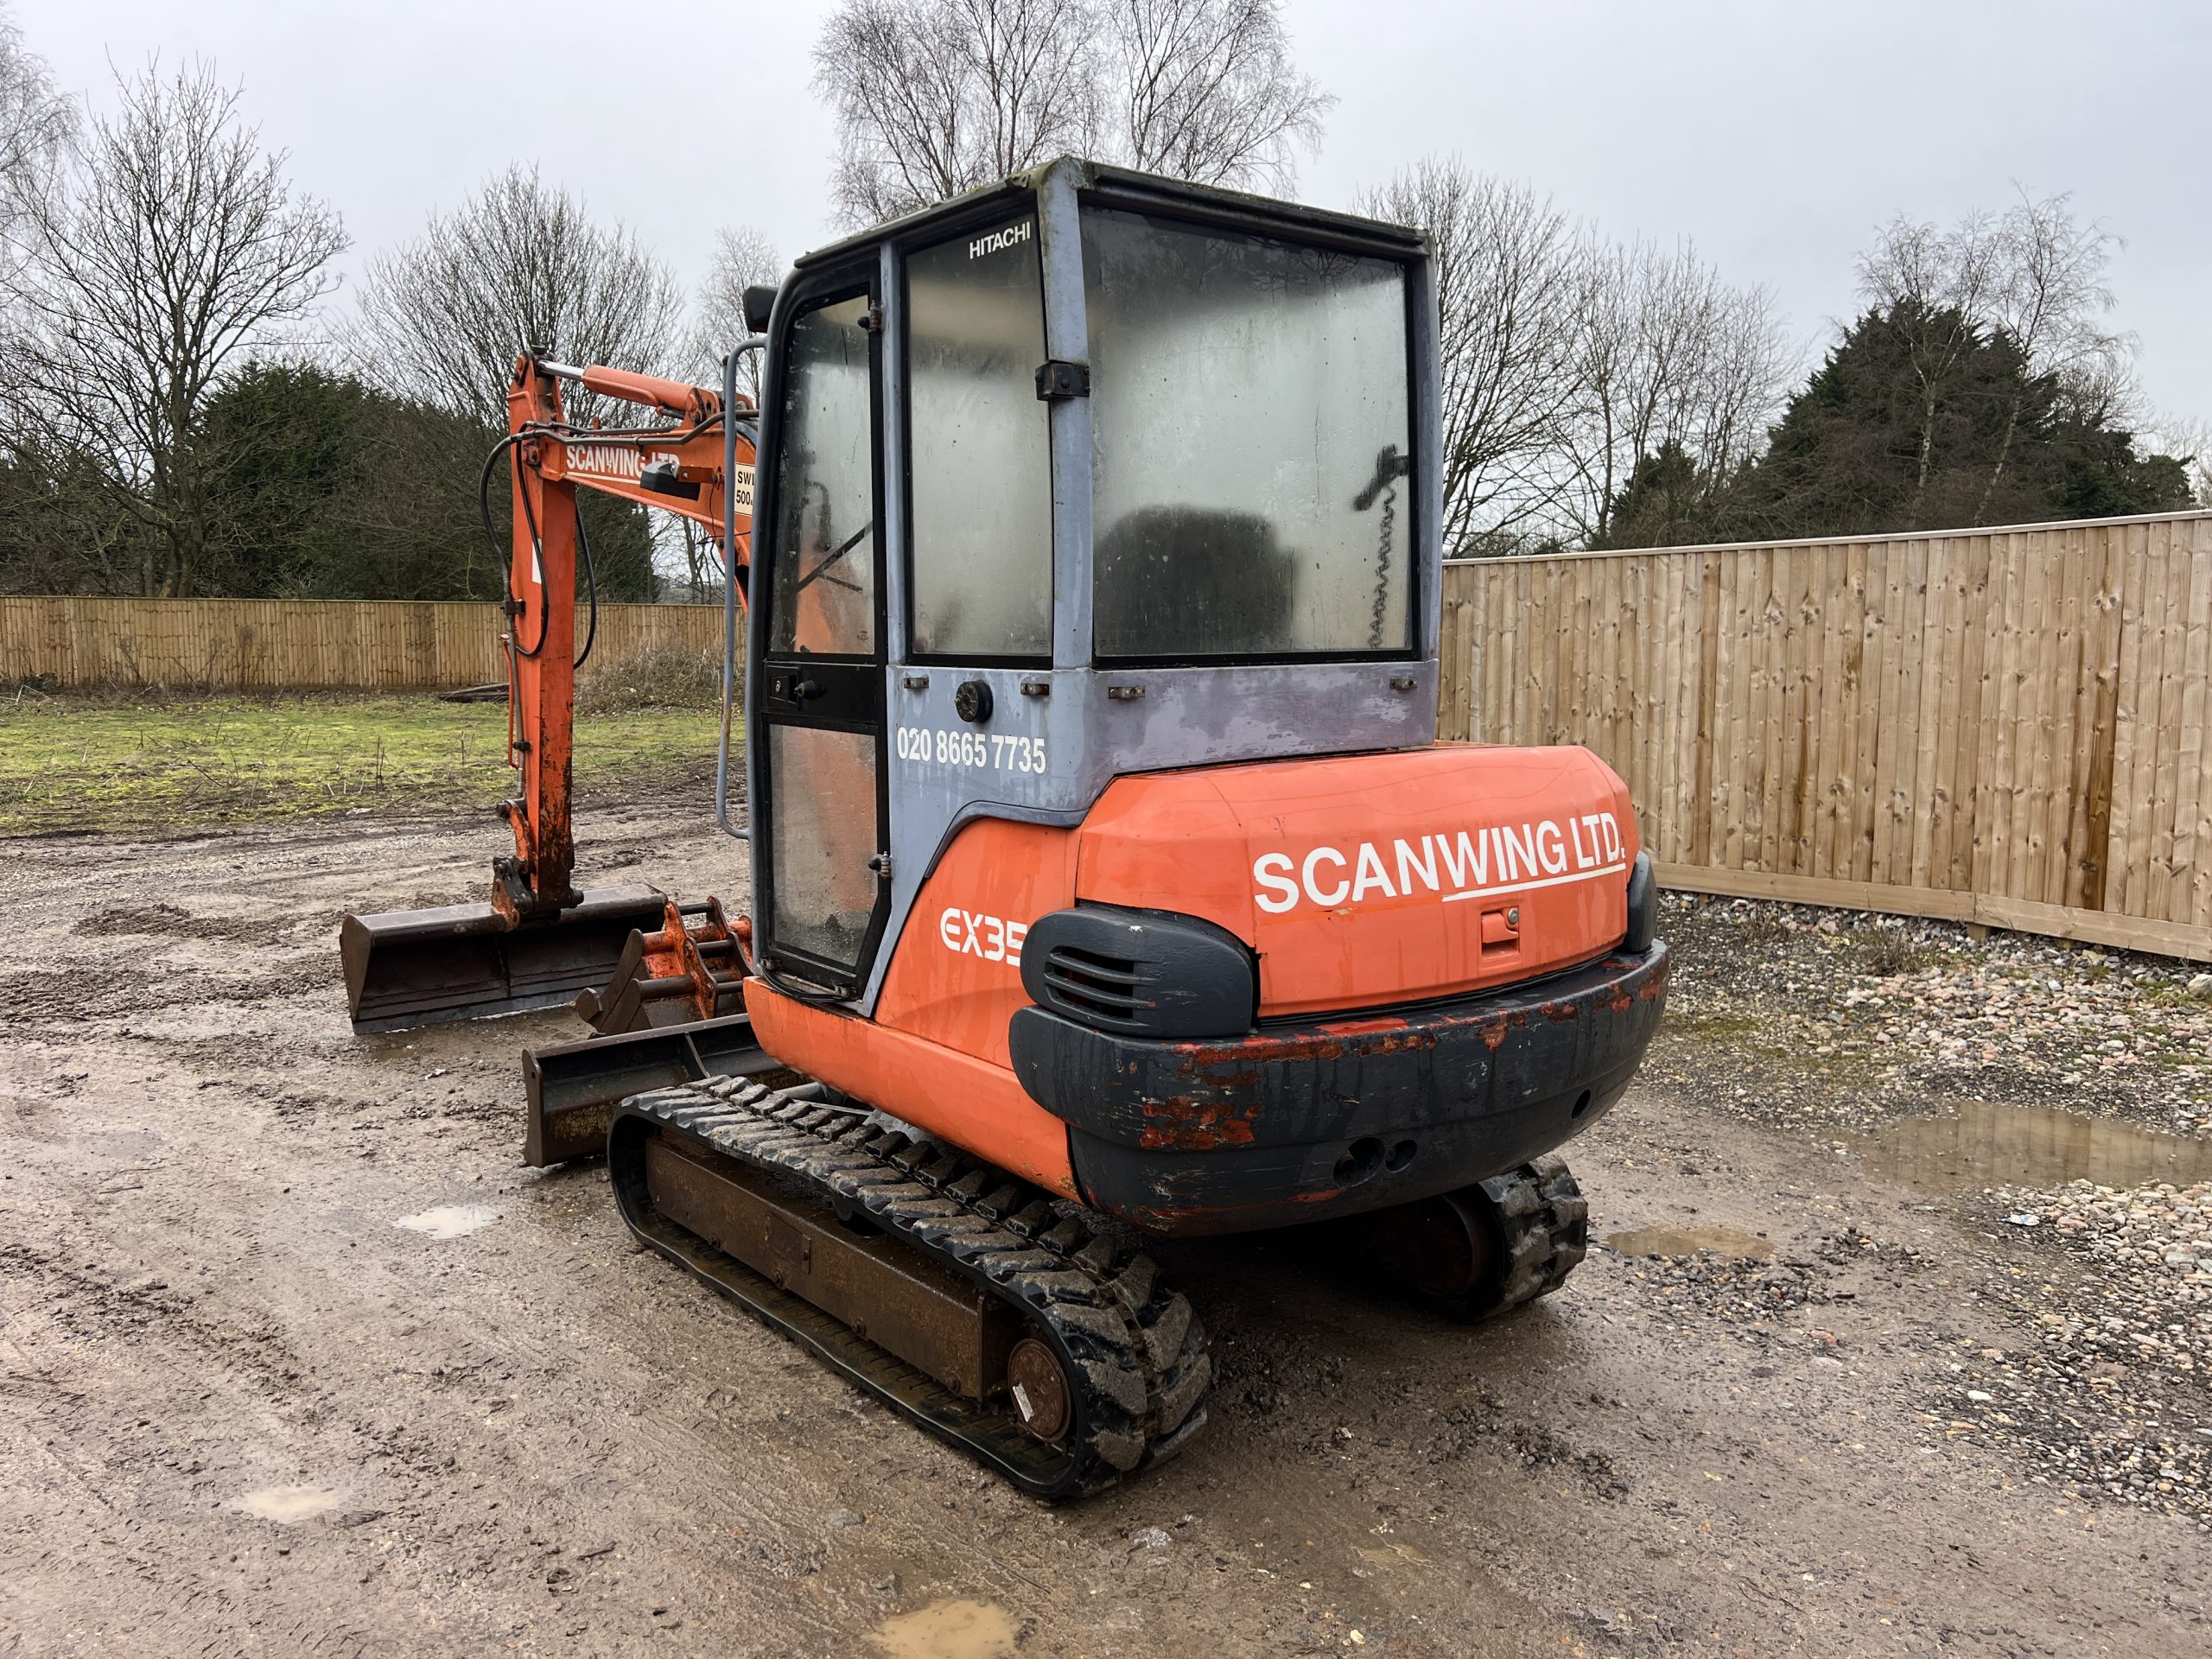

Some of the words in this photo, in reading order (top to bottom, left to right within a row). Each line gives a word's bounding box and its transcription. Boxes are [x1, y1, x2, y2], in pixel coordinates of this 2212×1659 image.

[969, 221, 1031, 259] HITACHI
[566, 444, 646, 479] SCANWING
[897, 727, 932, 762] 020
[936, 729, 987, 767] 8665
[991, 734, 1046, 774] 7735
[1253, 820, 1568, 913] SCANWING
[1569, 812, 1625, 868] LTD.
[940, 907, 1028, 967] EX35
